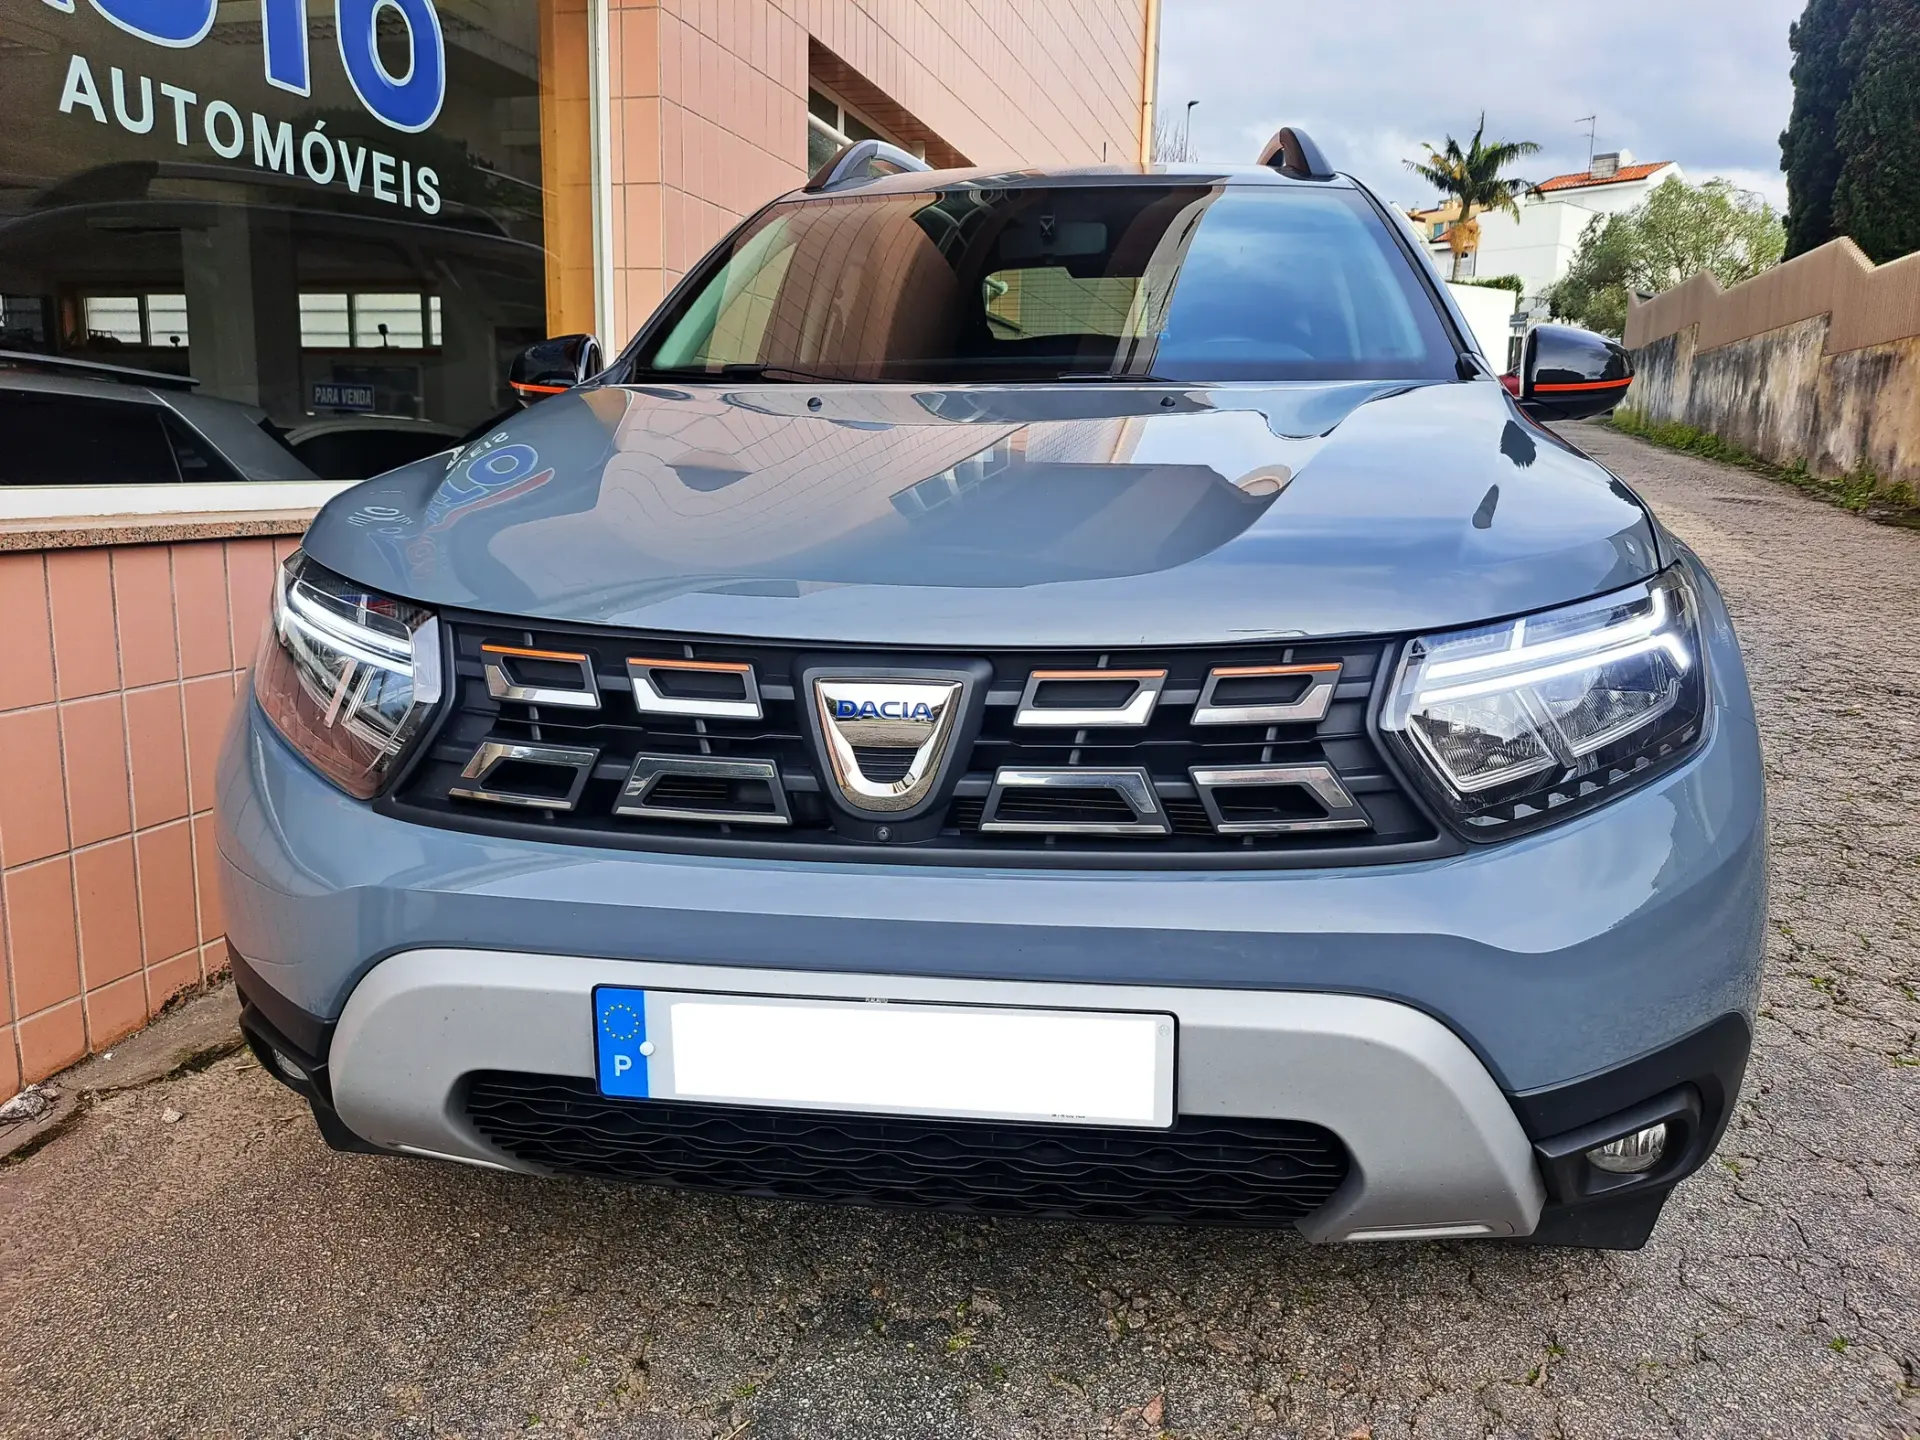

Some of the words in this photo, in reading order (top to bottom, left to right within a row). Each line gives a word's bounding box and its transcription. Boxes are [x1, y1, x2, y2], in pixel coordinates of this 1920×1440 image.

[58, 54, 442, 216] AUTOMÓVEIS
[314, 387, 340, 404] PARA
[341, 388, 372, 406] VENDA
[836, 699, 934, 721] DACIA
[614, 1054, 632, 1077] P
